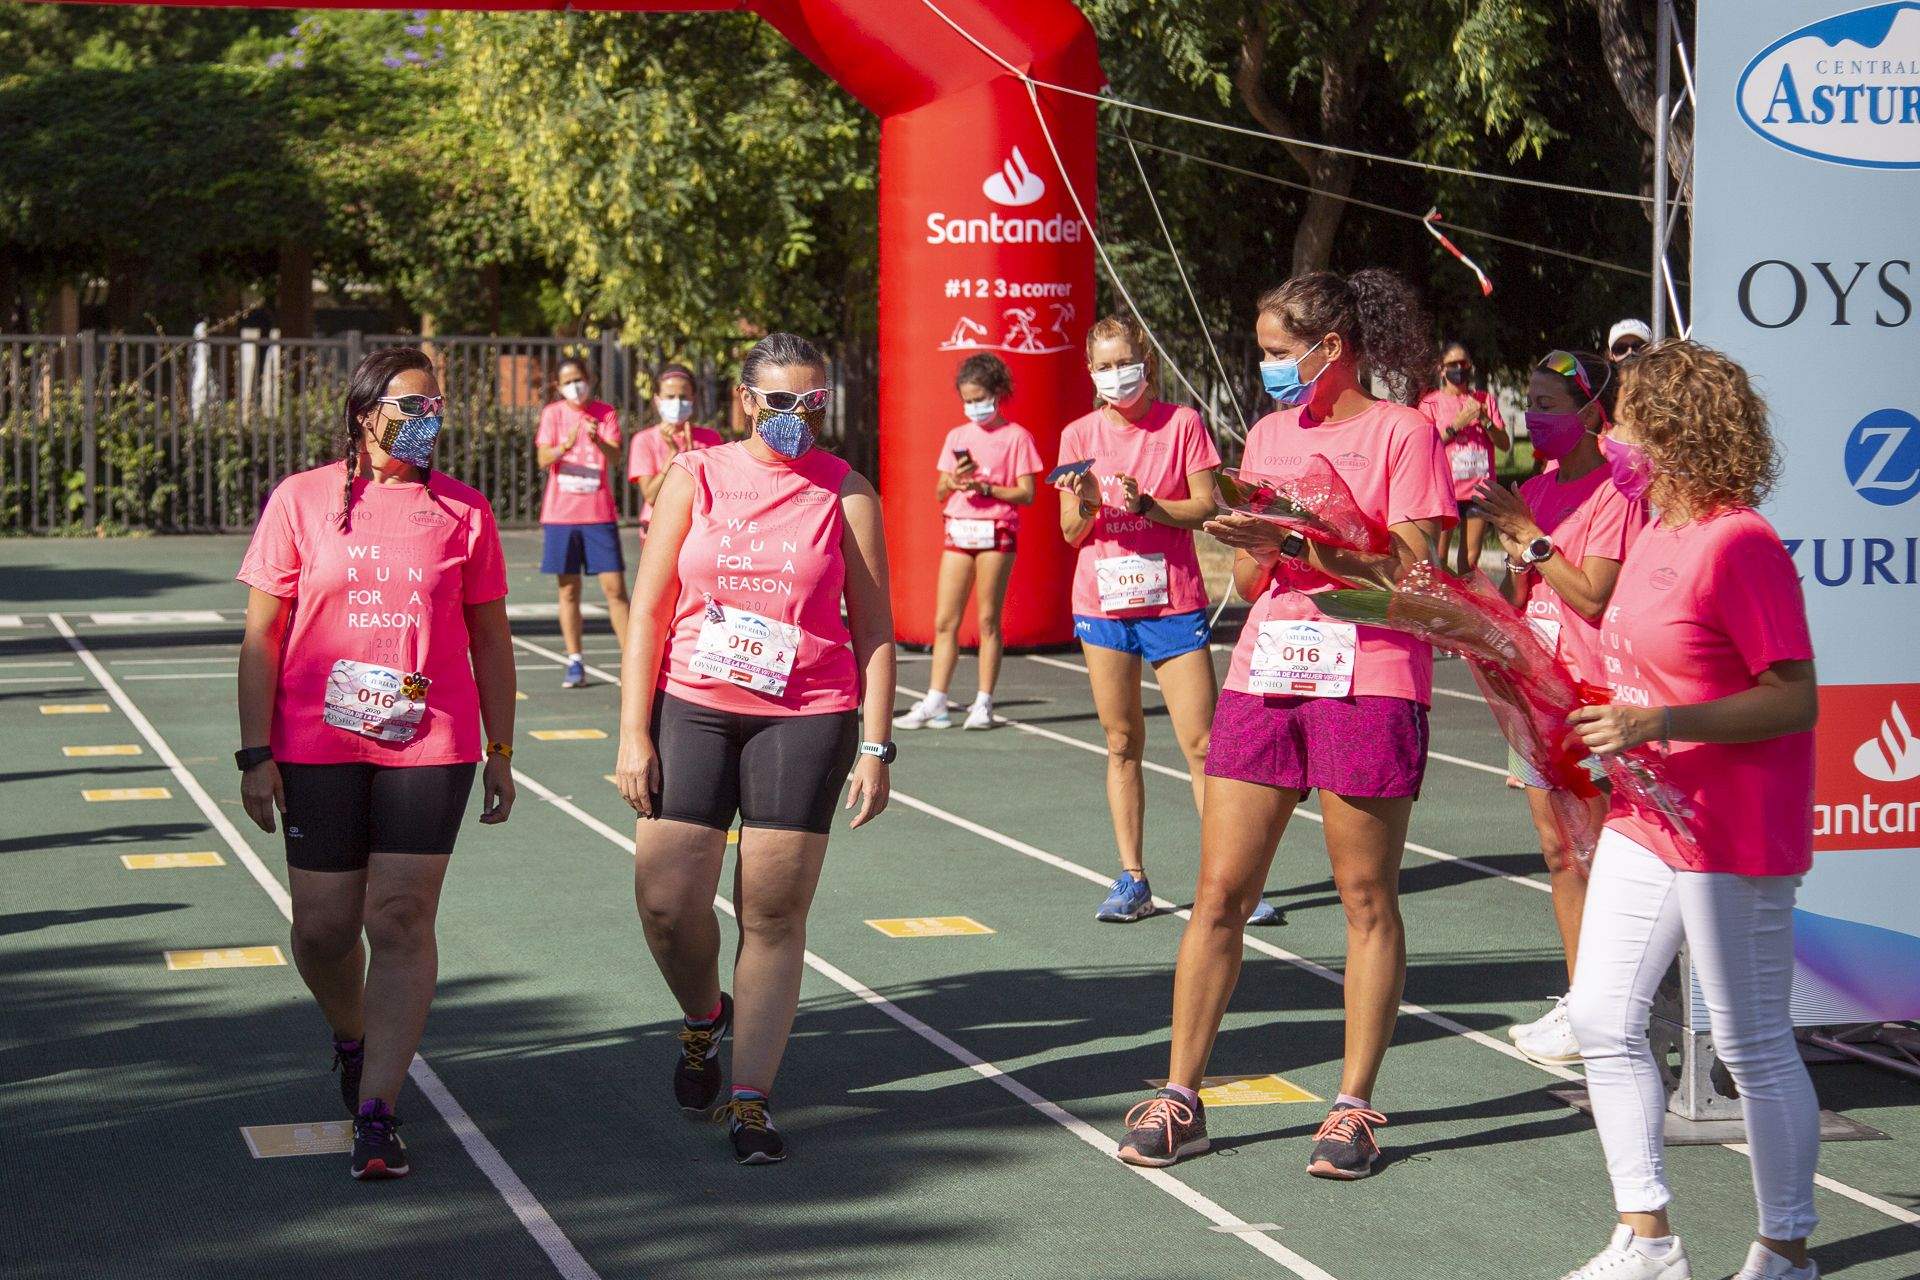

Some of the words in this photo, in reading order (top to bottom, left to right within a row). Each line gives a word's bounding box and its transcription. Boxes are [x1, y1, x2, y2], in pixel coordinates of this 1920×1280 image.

[926, 212, 1083, 244] Santander
[1738, 259, 1912, 328] OYS
[1264, 456, 1302, 466] OYSHO
[715, 490, 760, 501] OYSHO
[728, 518, 759, 533] WE
[1105, 519, 1153, 534] REASON
[347, 545, 380, 559] WE
[717, 554, 753, 571] FOR
[781, 560, 795, 574] A
[717, 575, 793, 597] REASON
[1119, 573, 1145, 585] 016
[347, 590, 383, 605] FOR
[409, 590, 422, 605] A
[347, 612, 421, 628] REASON
[729, 634, 764, 656] 016
[1282, 646, 1320, 662] 016
[694, 660, 723, 673] OYSHO
[1252, 680, 1283, 689] OYSHO
[357, 688, 396, 709] 016
